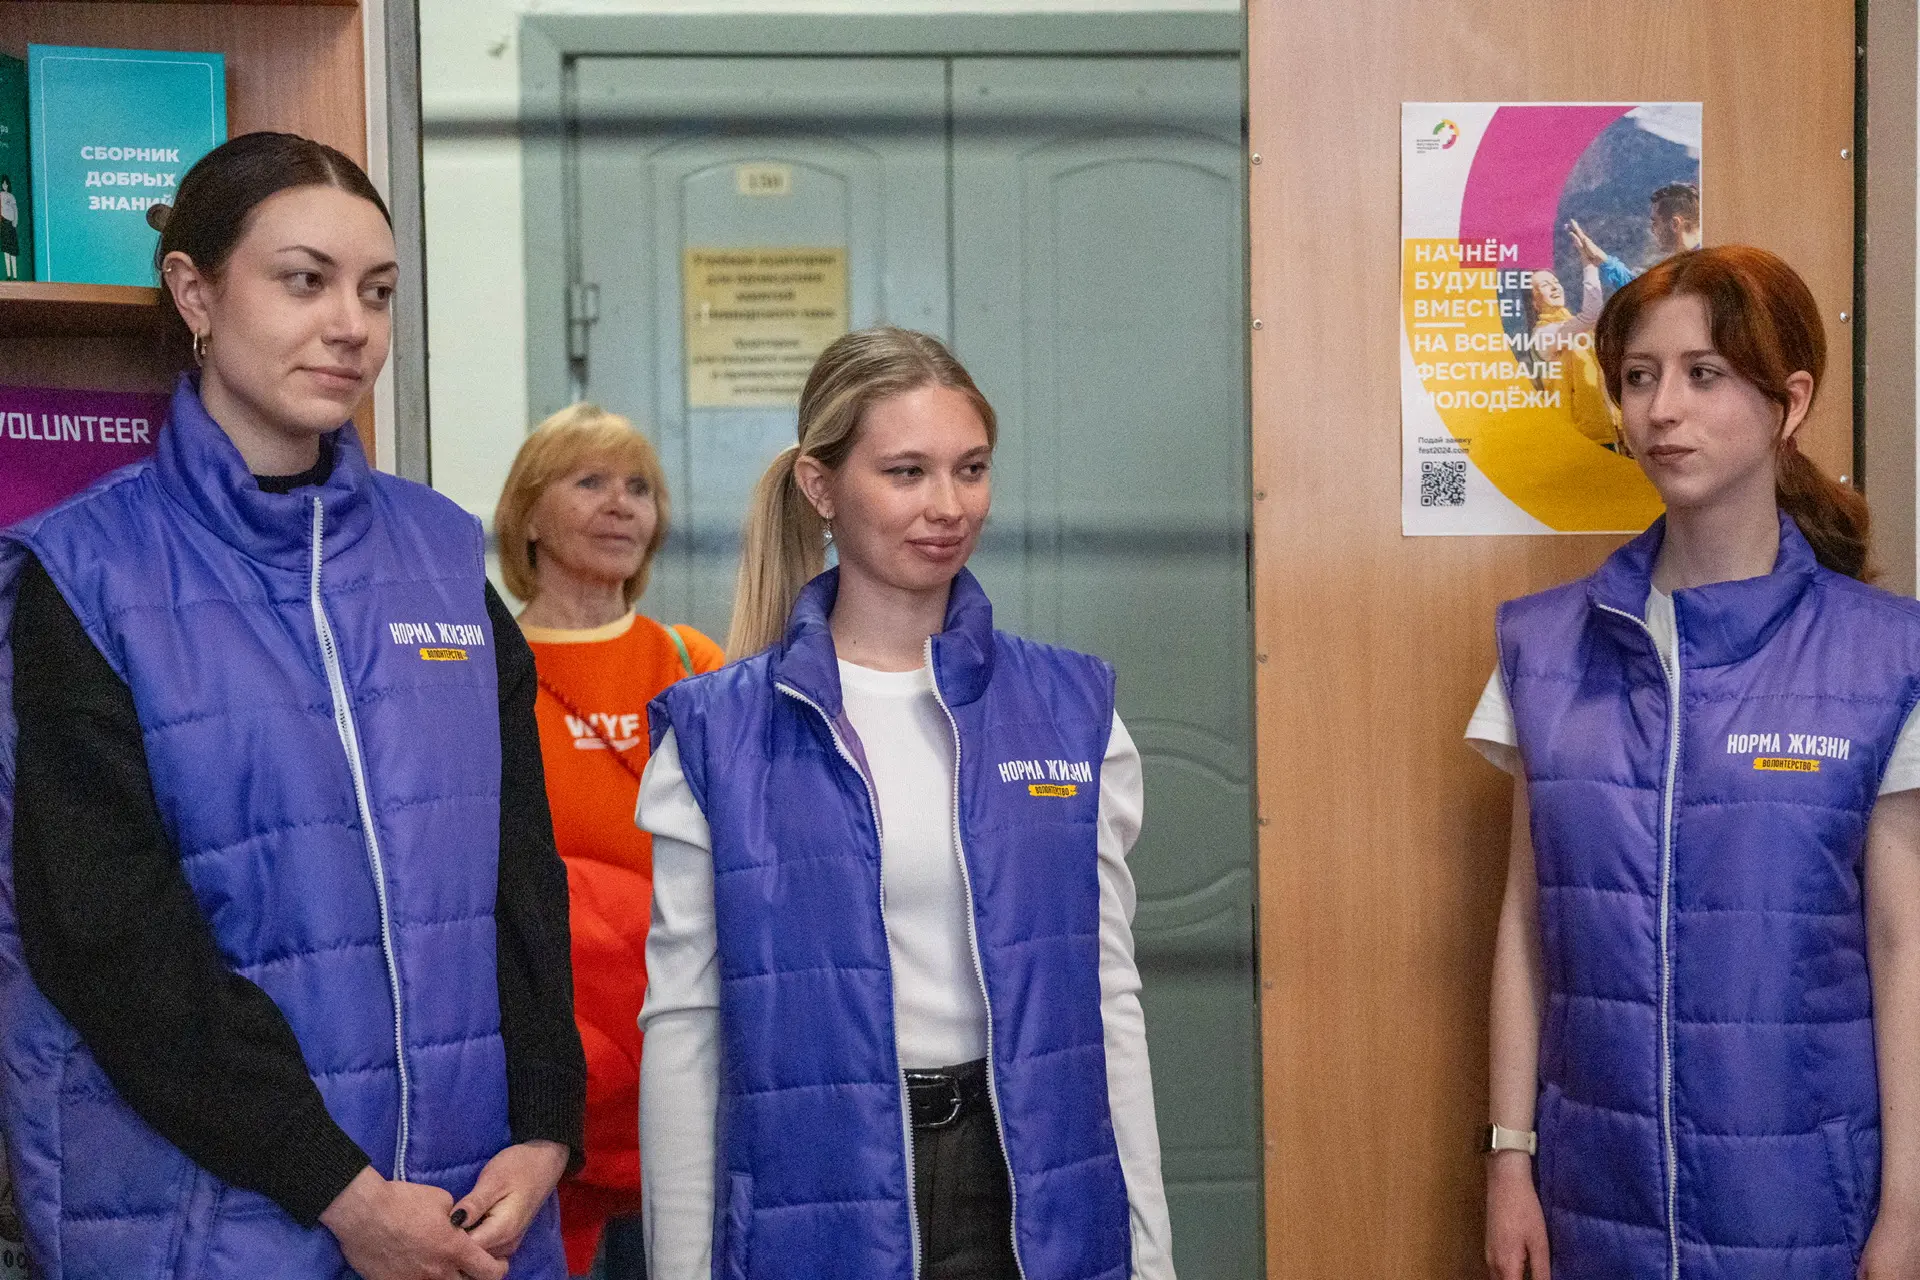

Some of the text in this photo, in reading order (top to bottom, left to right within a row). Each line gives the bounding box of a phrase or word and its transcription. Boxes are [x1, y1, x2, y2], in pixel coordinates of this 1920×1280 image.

[80, 146, 179, 163] СБОРНИК
[85, 171, 177, 187] ДОБРЫХ
[1414, 238, 1519, 263] НАЧНЁМ
[1414, 271, 1534, 294] БУДУЩЕЕ
[1413, 298, 1522, 318] ВМЕСТЕ!
[1414, 332, 1594, 353] НА ВСЕМИРНО
[1415, 361, 1564, 382] ФЕСТИВАЛЕ
[1418, 436, 1443, 444] Подай
[389, 622, 485, 646] НОРМА ЖИЗНИ
[1727, 733, 1850, 760] НОРМА ЖИЗНИ
[998, 760, 1045, 783] НОРМА
[1762, 759, 1811, 771] ВОЛОНТЕРСТВО
